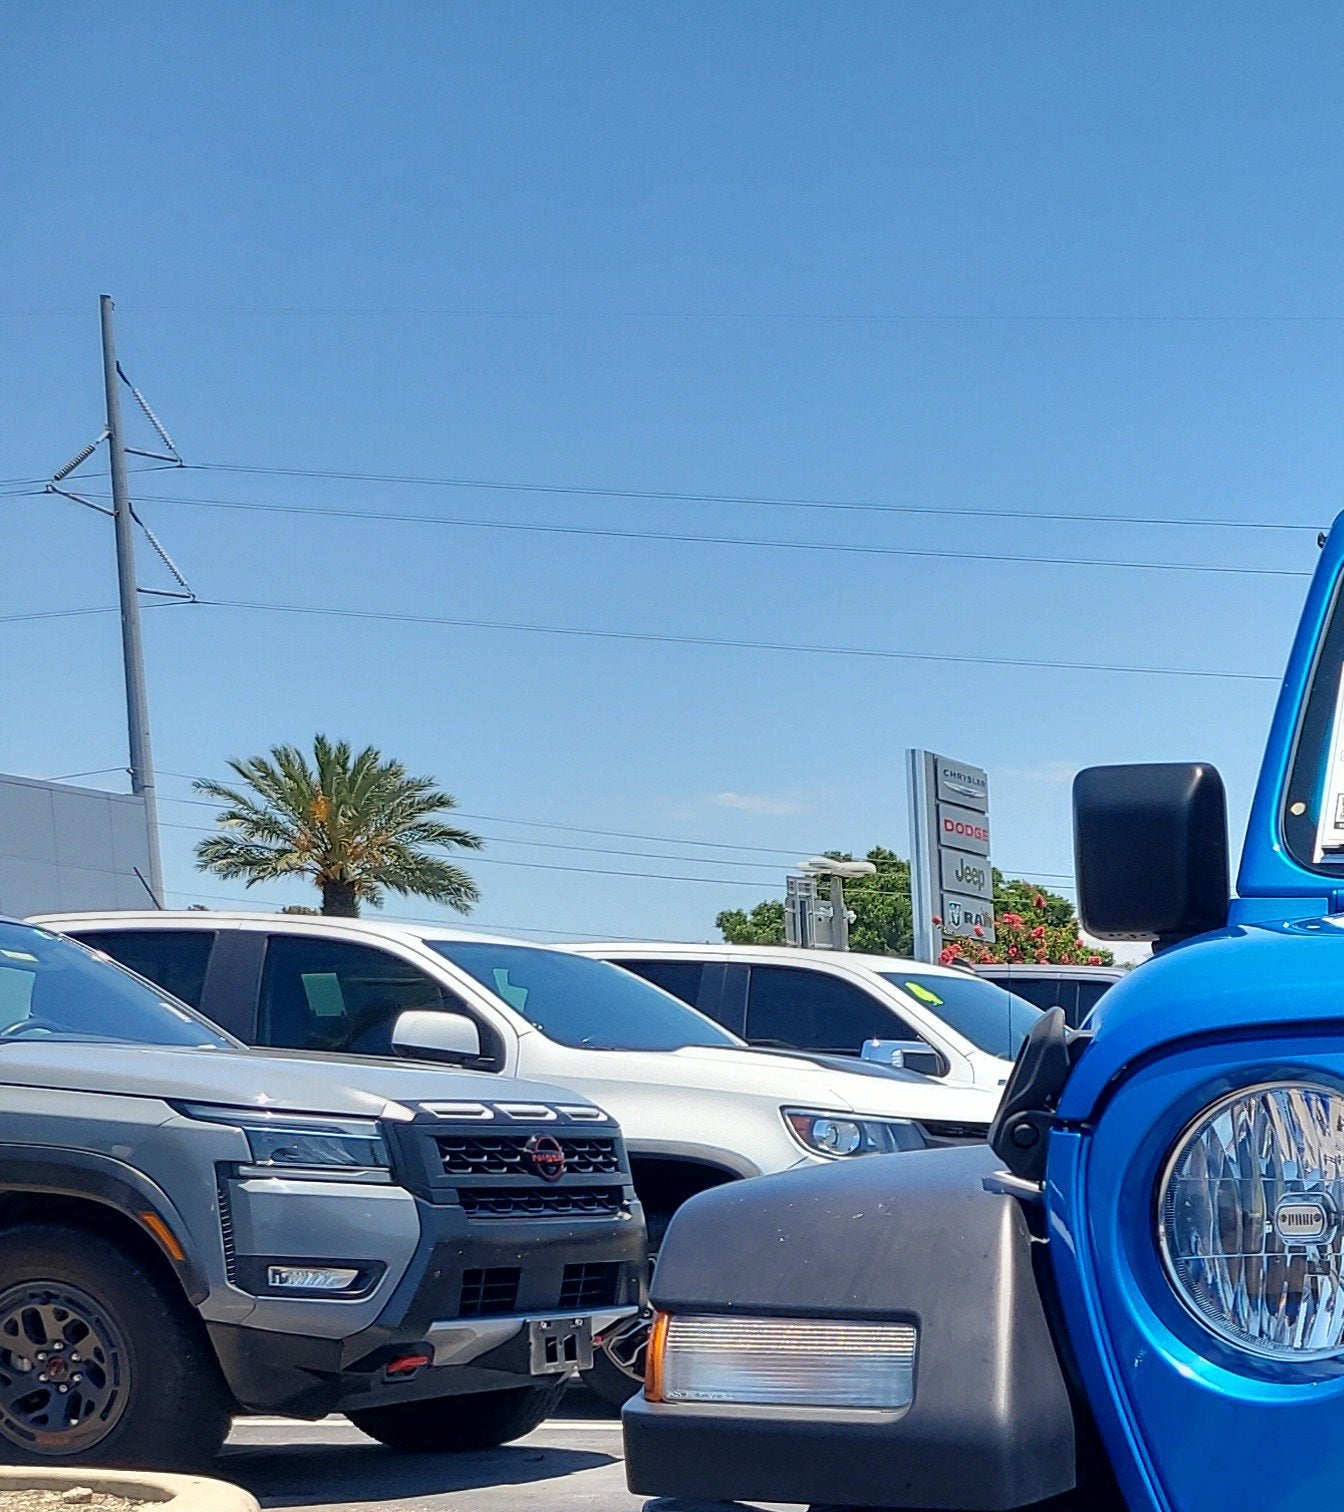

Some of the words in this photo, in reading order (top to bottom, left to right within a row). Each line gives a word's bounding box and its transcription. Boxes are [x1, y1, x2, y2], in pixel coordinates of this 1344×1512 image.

[943, 769, 986, 787] CHRYSLER
[944, 818, 989, 841] DODGE
[955, 858, 985, 891] Jeep
